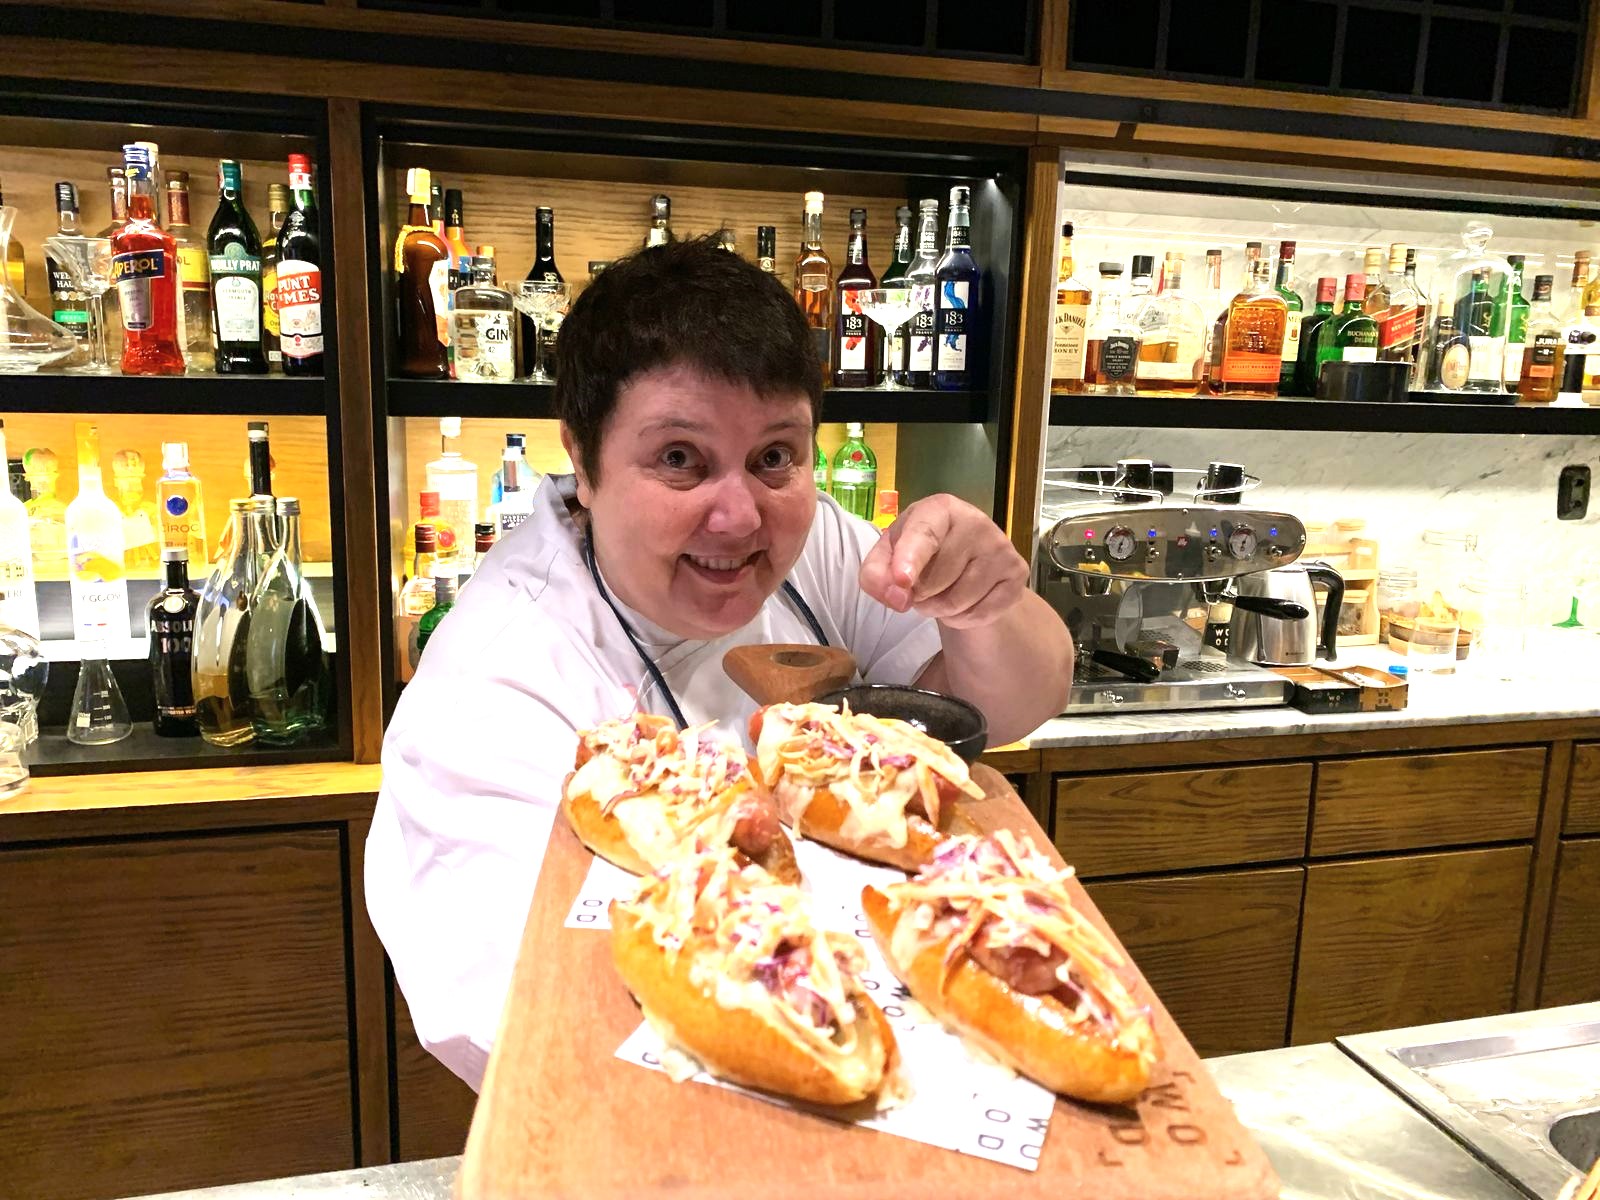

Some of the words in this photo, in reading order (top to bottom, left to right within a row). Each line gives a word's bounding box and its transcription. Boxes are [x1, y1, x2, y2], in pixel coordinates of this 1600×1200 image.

[113, 257, 158, 279] APEROL
[278, 275, 311, 293] PUNT
[485, 328, 509, 341] GIN
[1535, 337, 1558, 345] JURA
